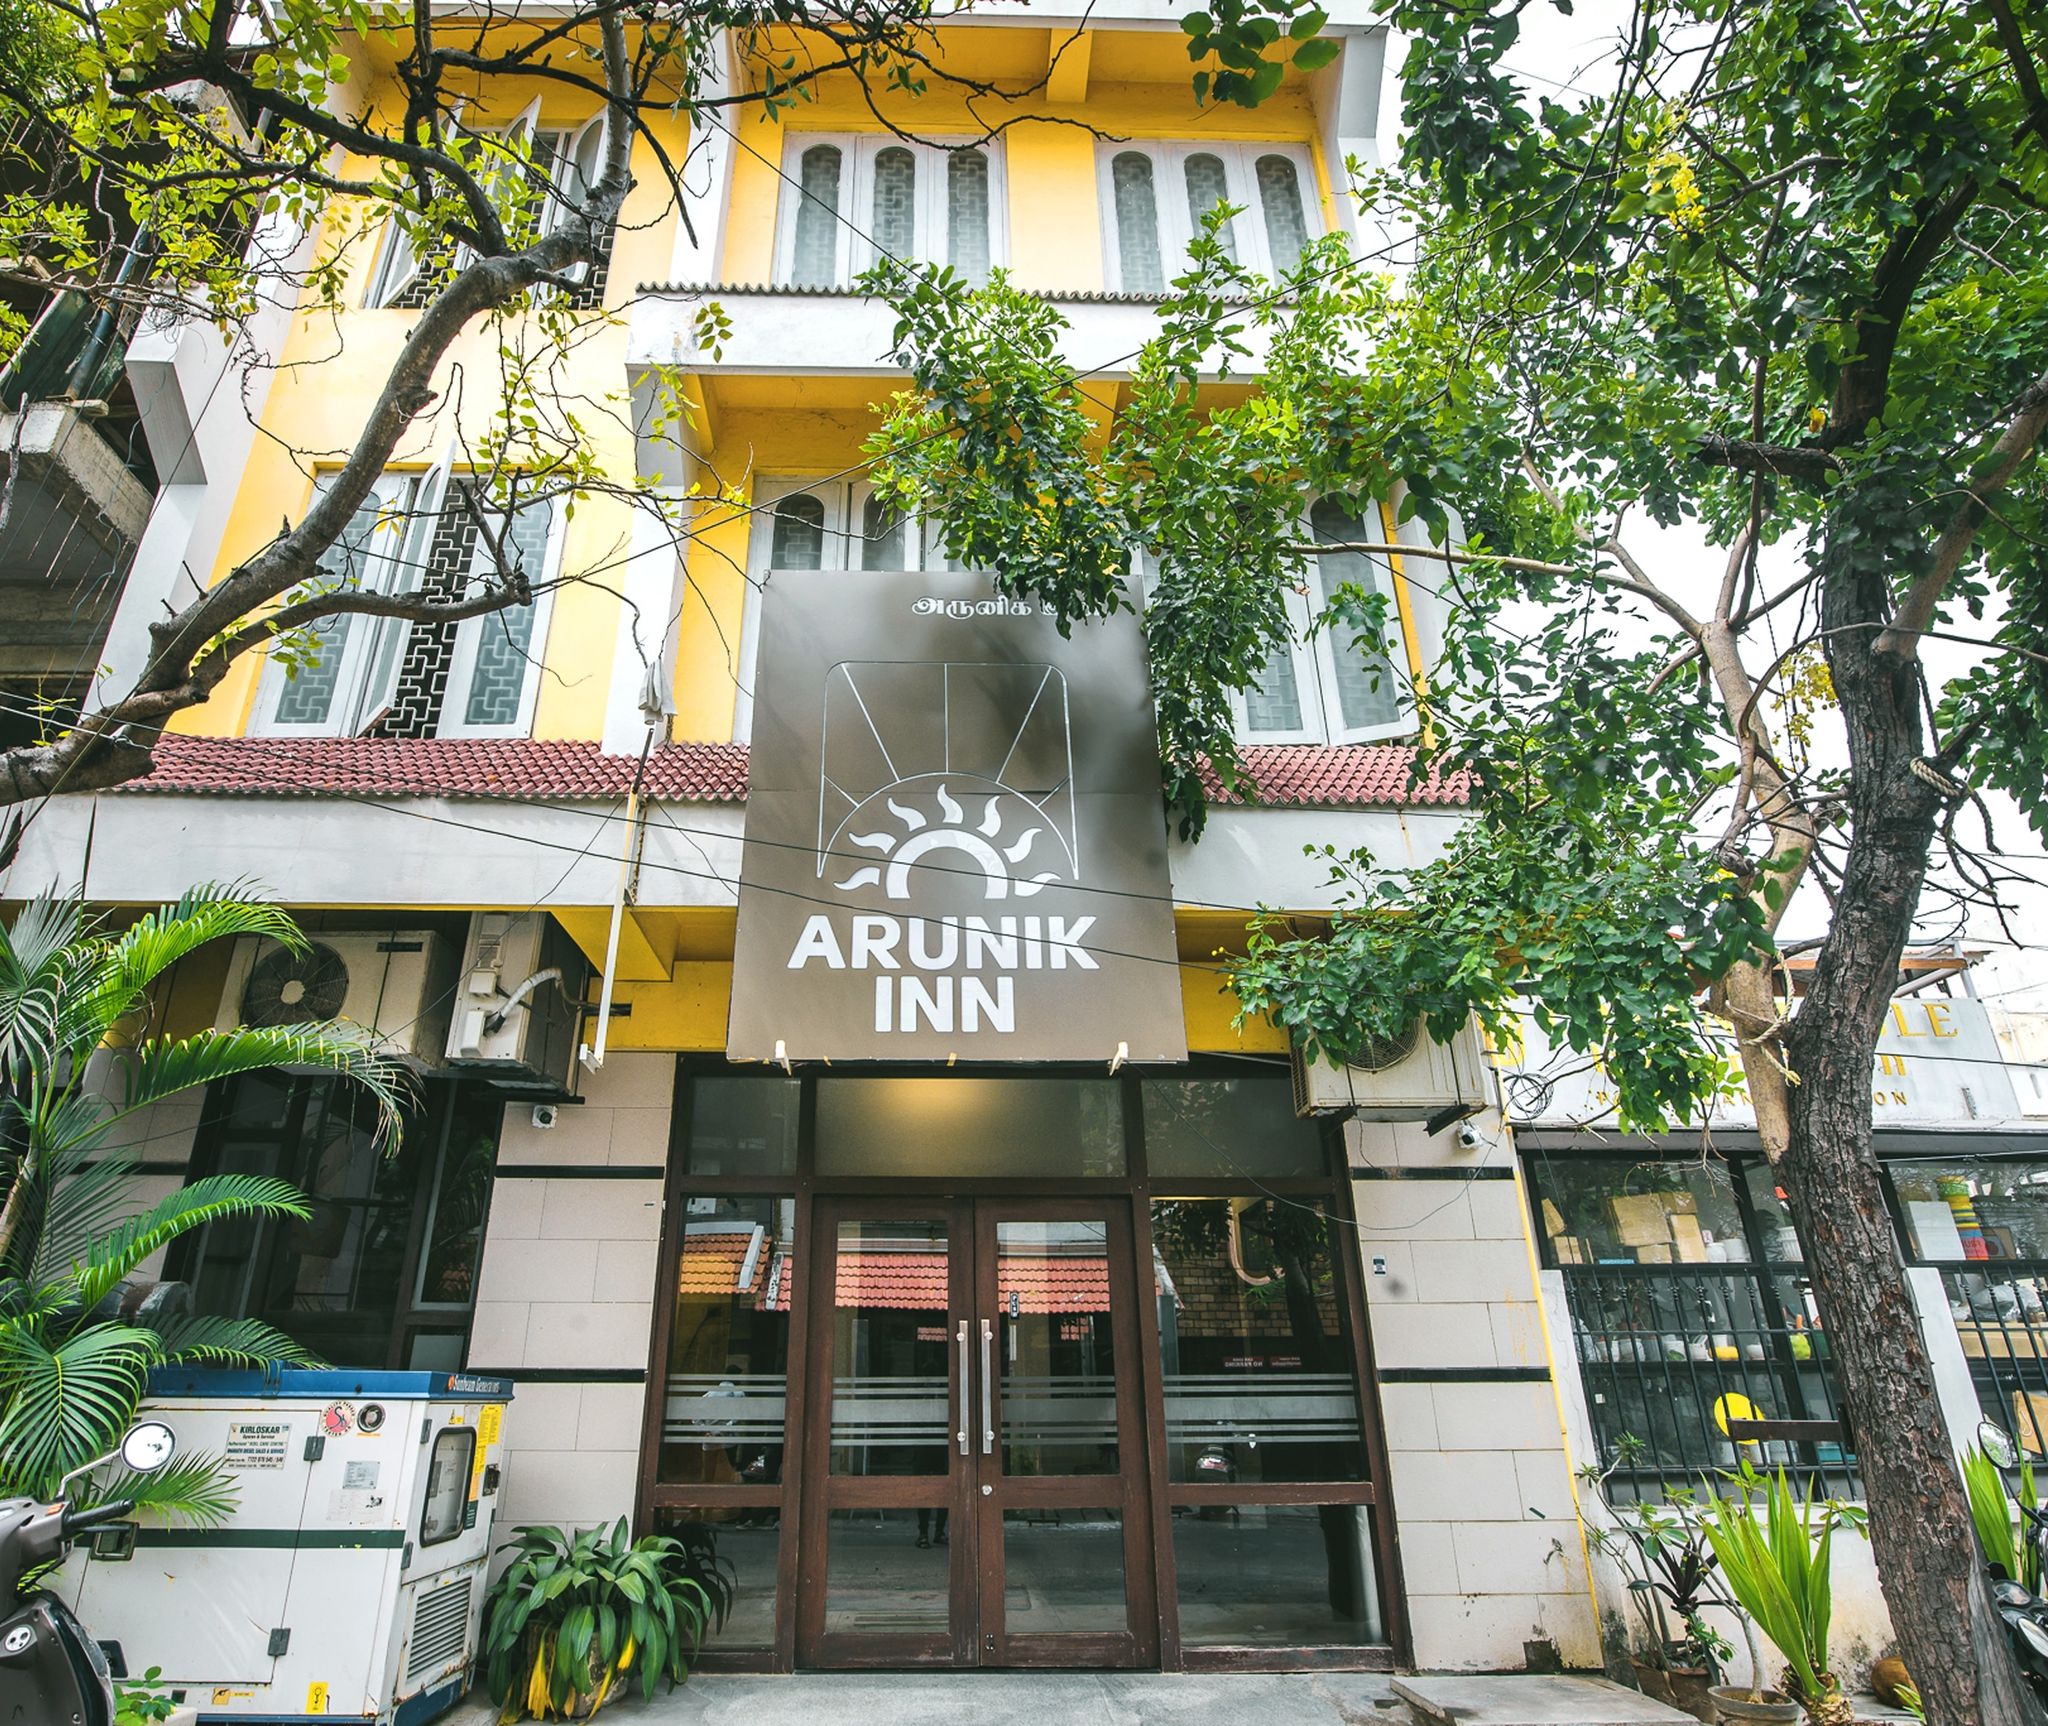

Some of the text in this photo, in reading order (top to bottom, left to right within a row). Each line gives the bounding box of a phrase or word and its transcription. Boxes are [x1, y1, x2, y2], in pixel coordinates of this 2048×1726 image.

[786, 915, 1100, 969] ARUNIK
[874, 975, 1016, 1032] INN
[240, 1425, 281, 1434] KIRLOSKAR
